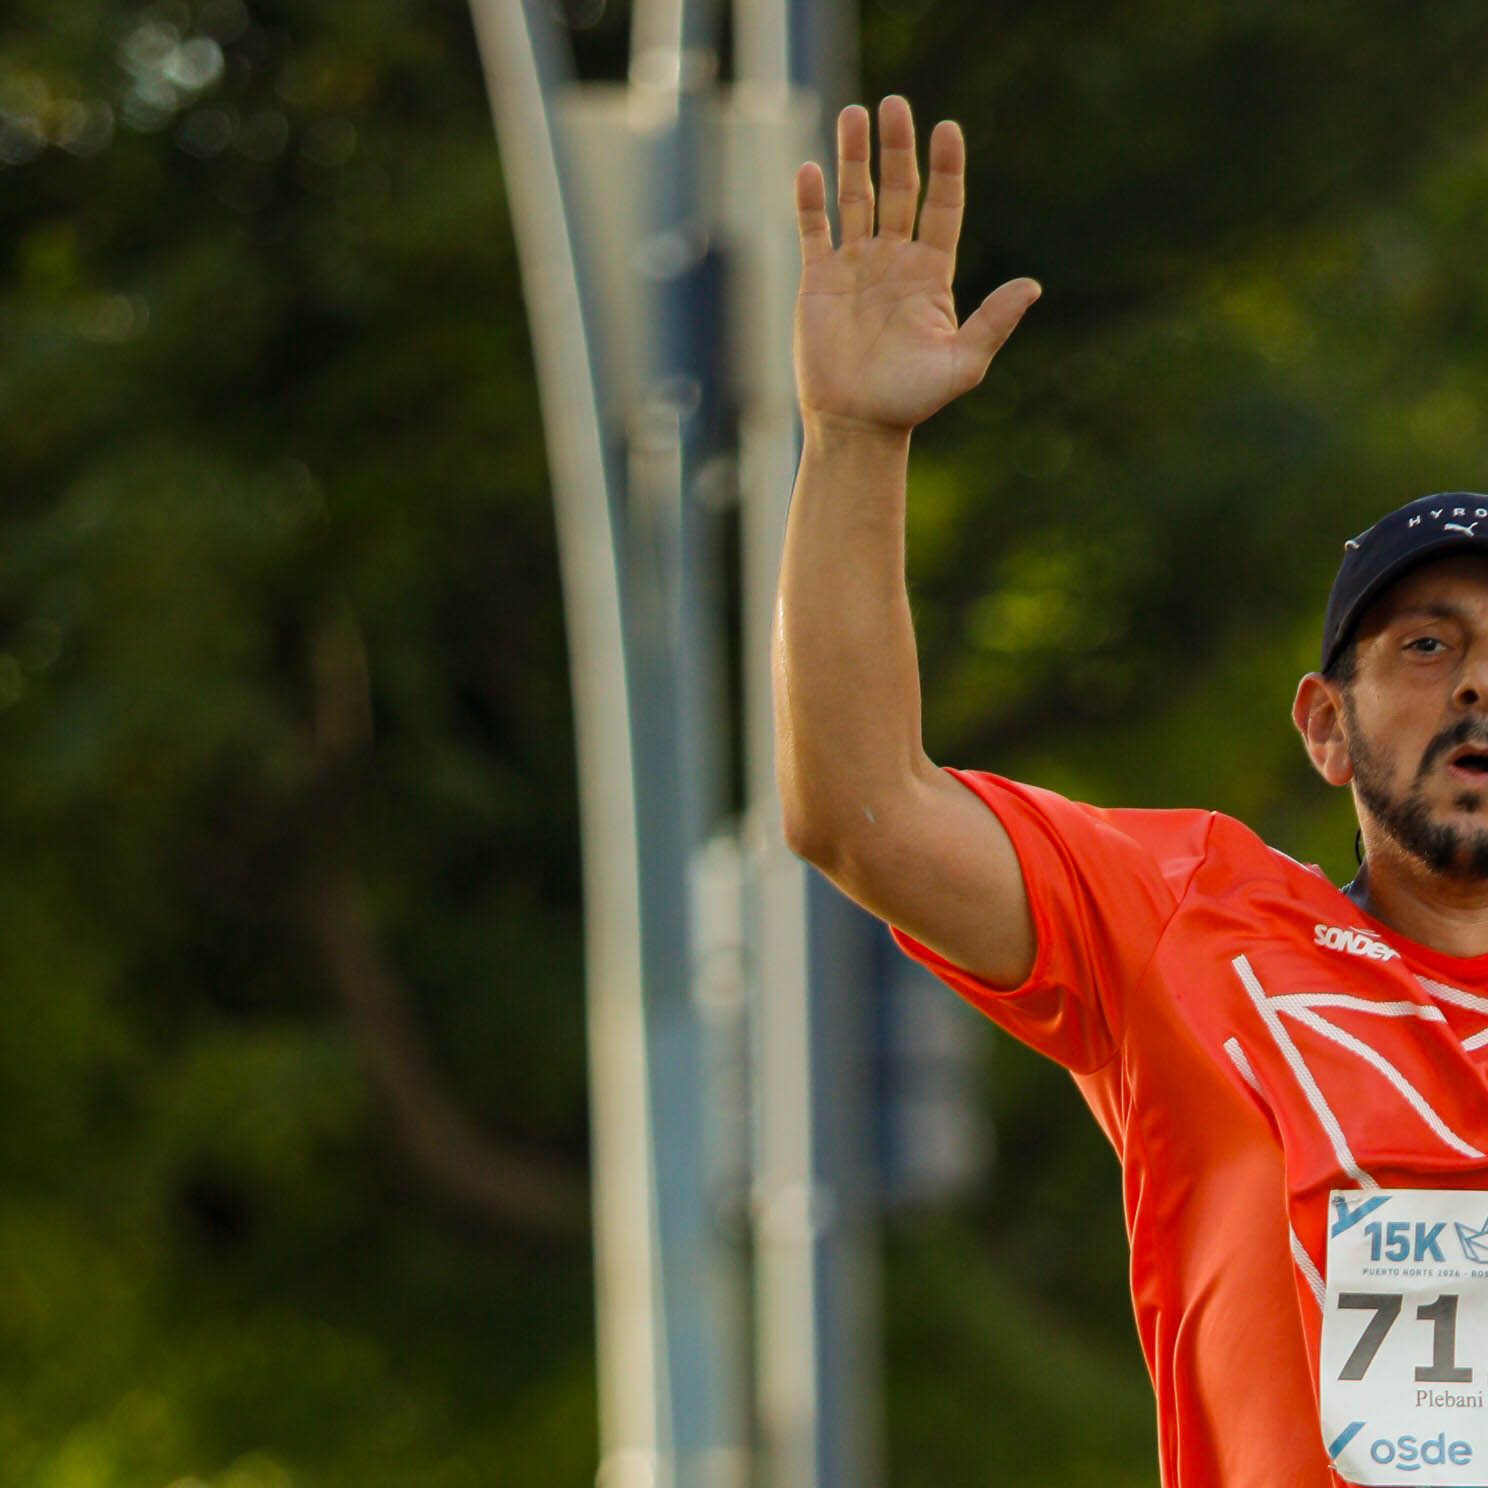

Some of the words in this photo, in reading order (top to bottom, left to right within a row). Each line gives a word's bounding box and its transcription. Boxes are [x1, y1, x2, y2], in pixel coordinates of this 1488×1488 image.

[1364, 1221, 1448, 1263] 15K
[1362, 1268, 1400, 1277] PUERTO
[1402, 1268, 1433, 1277] NORTE
[1415, 1390, 1484, 1408] Plebani
[1370, 1432, 1473, 1471] osde
